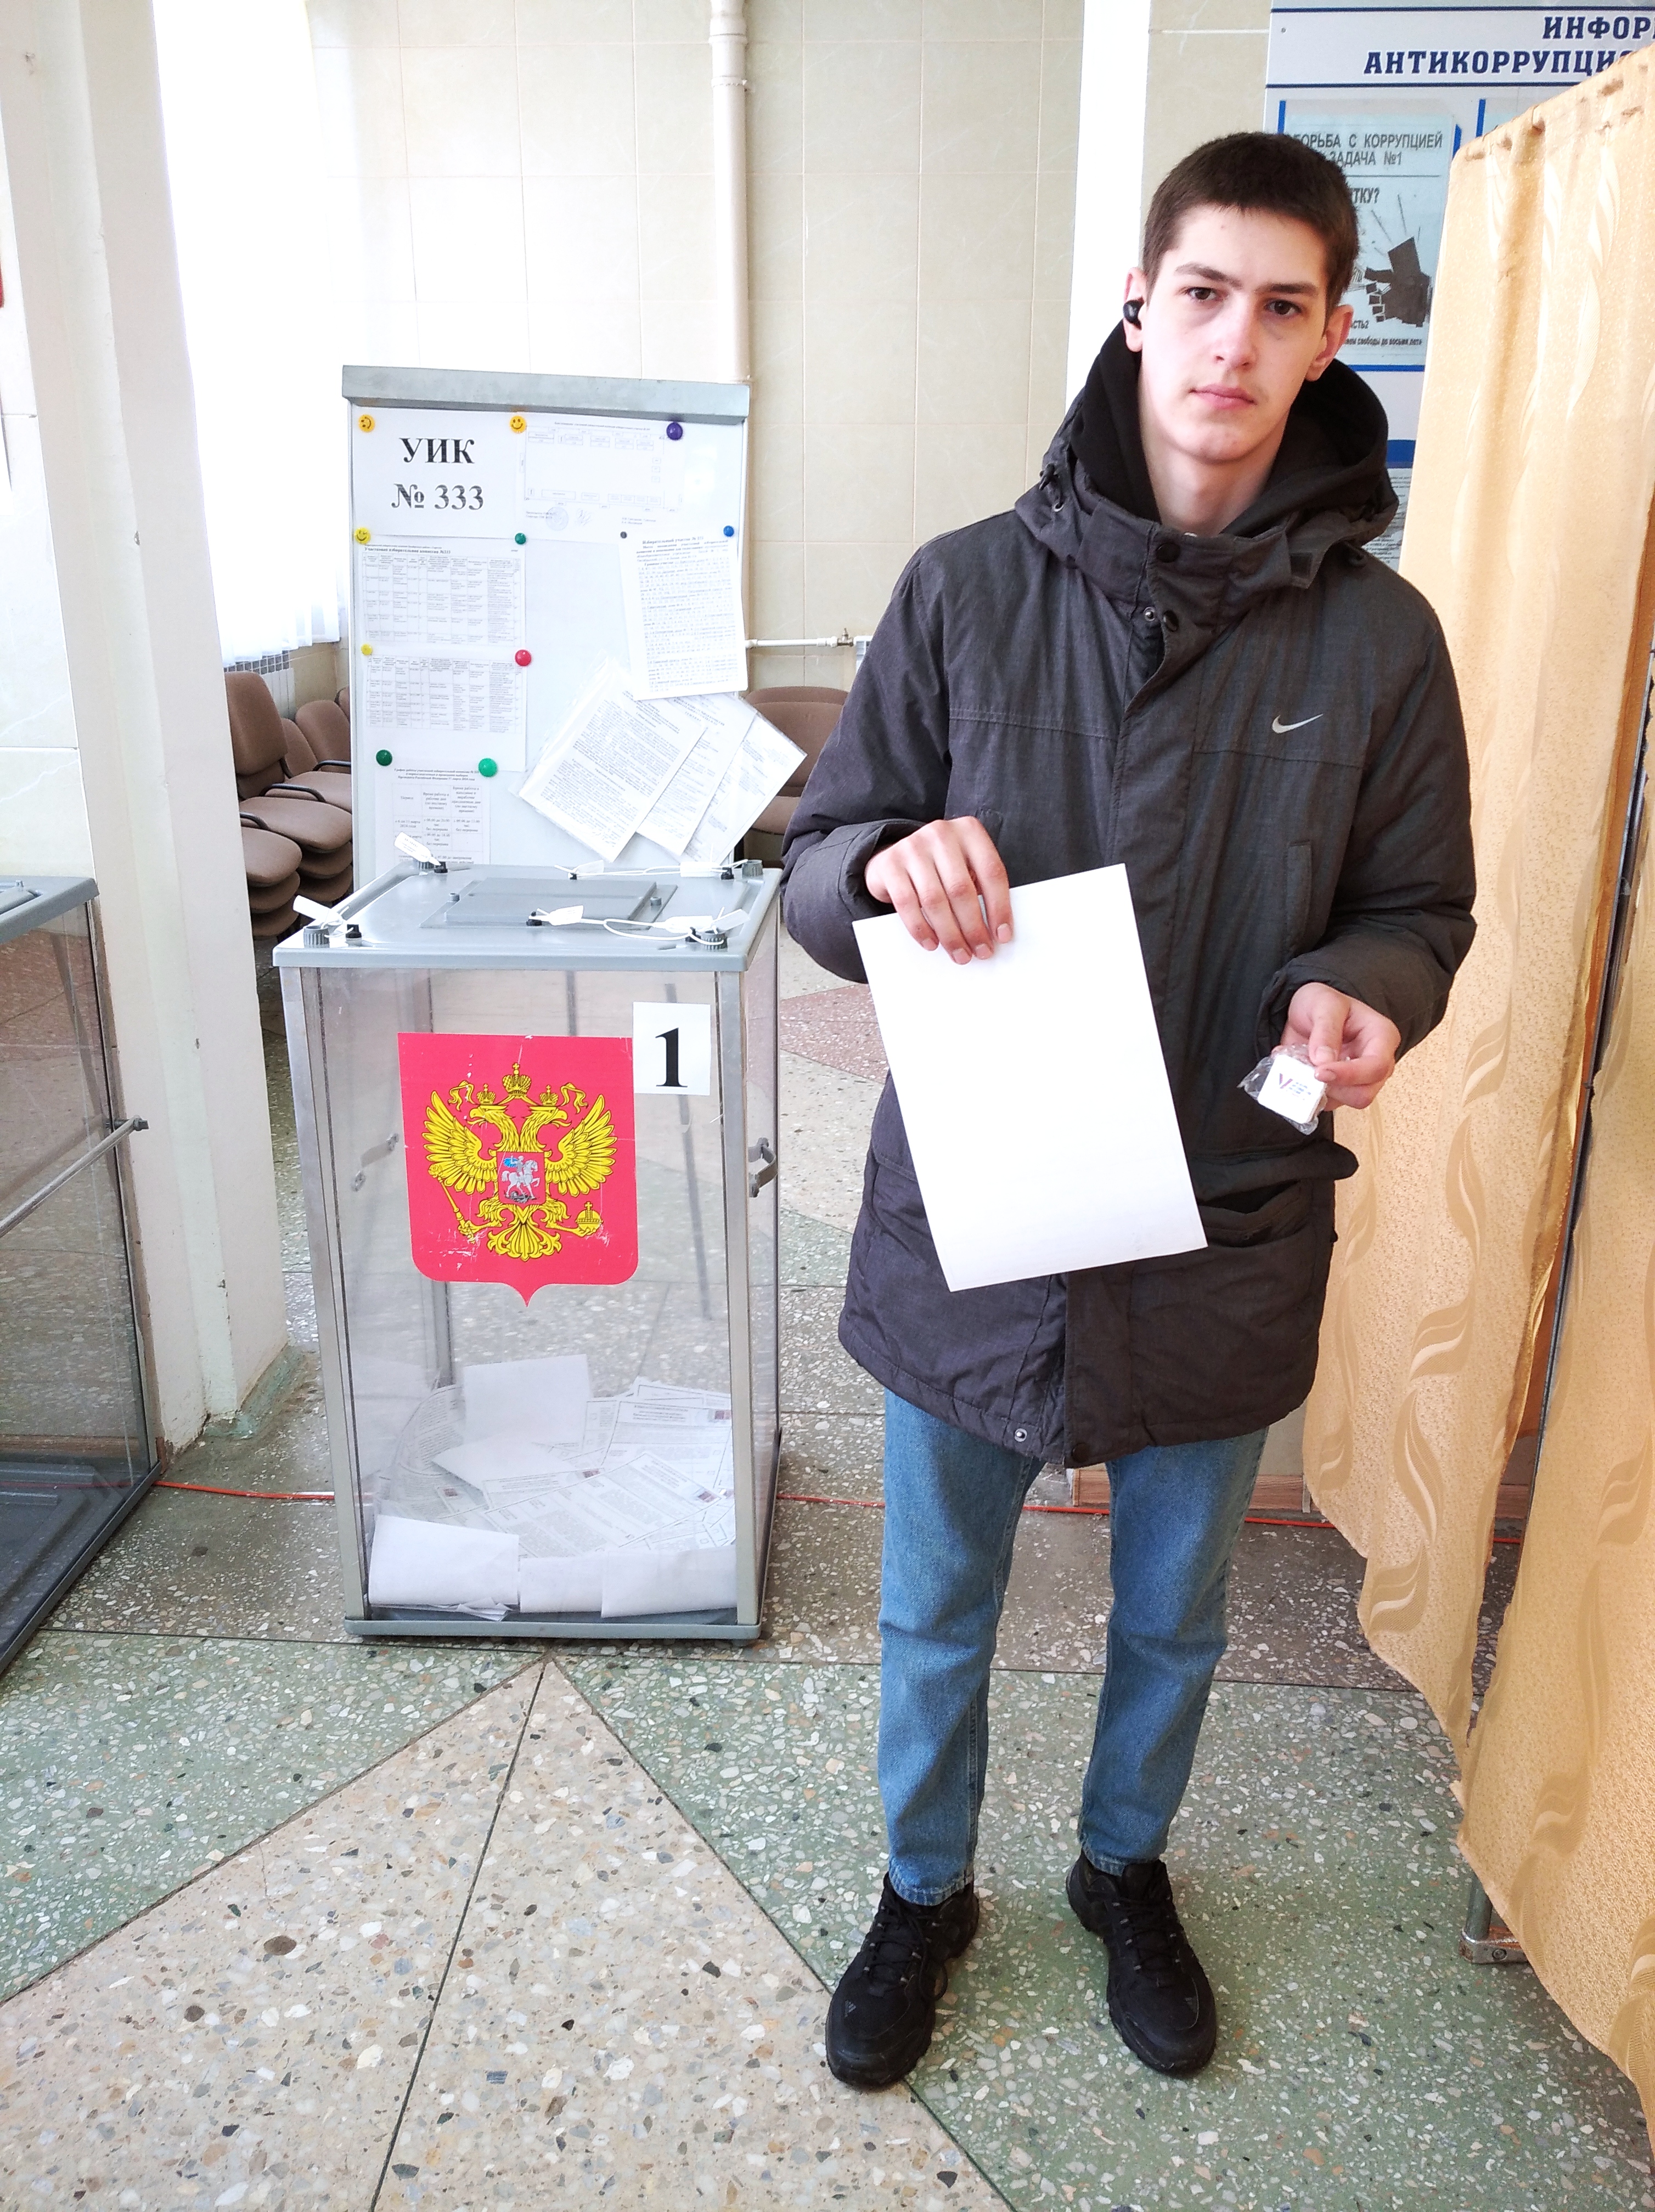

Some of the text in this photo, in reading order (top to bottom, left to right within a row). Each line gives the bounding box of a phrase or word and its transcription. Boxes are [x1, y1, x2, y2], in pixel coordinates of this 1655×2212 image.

[1543, 16, 1655, 40] ИНФОР
[1364, 50, 1632, 77] АНТИКОРРУПЦИ
[1349, 133, 1357, 148] С
[1364, 131, 1443, 150] КОРРУПЦИЕЙ
[1383, 151, 1402, 165] №1
[399, 437, 475, 464] УИК
[391, 483, 483, 510] № 333
[655, 1027, 688, 1088] 1
